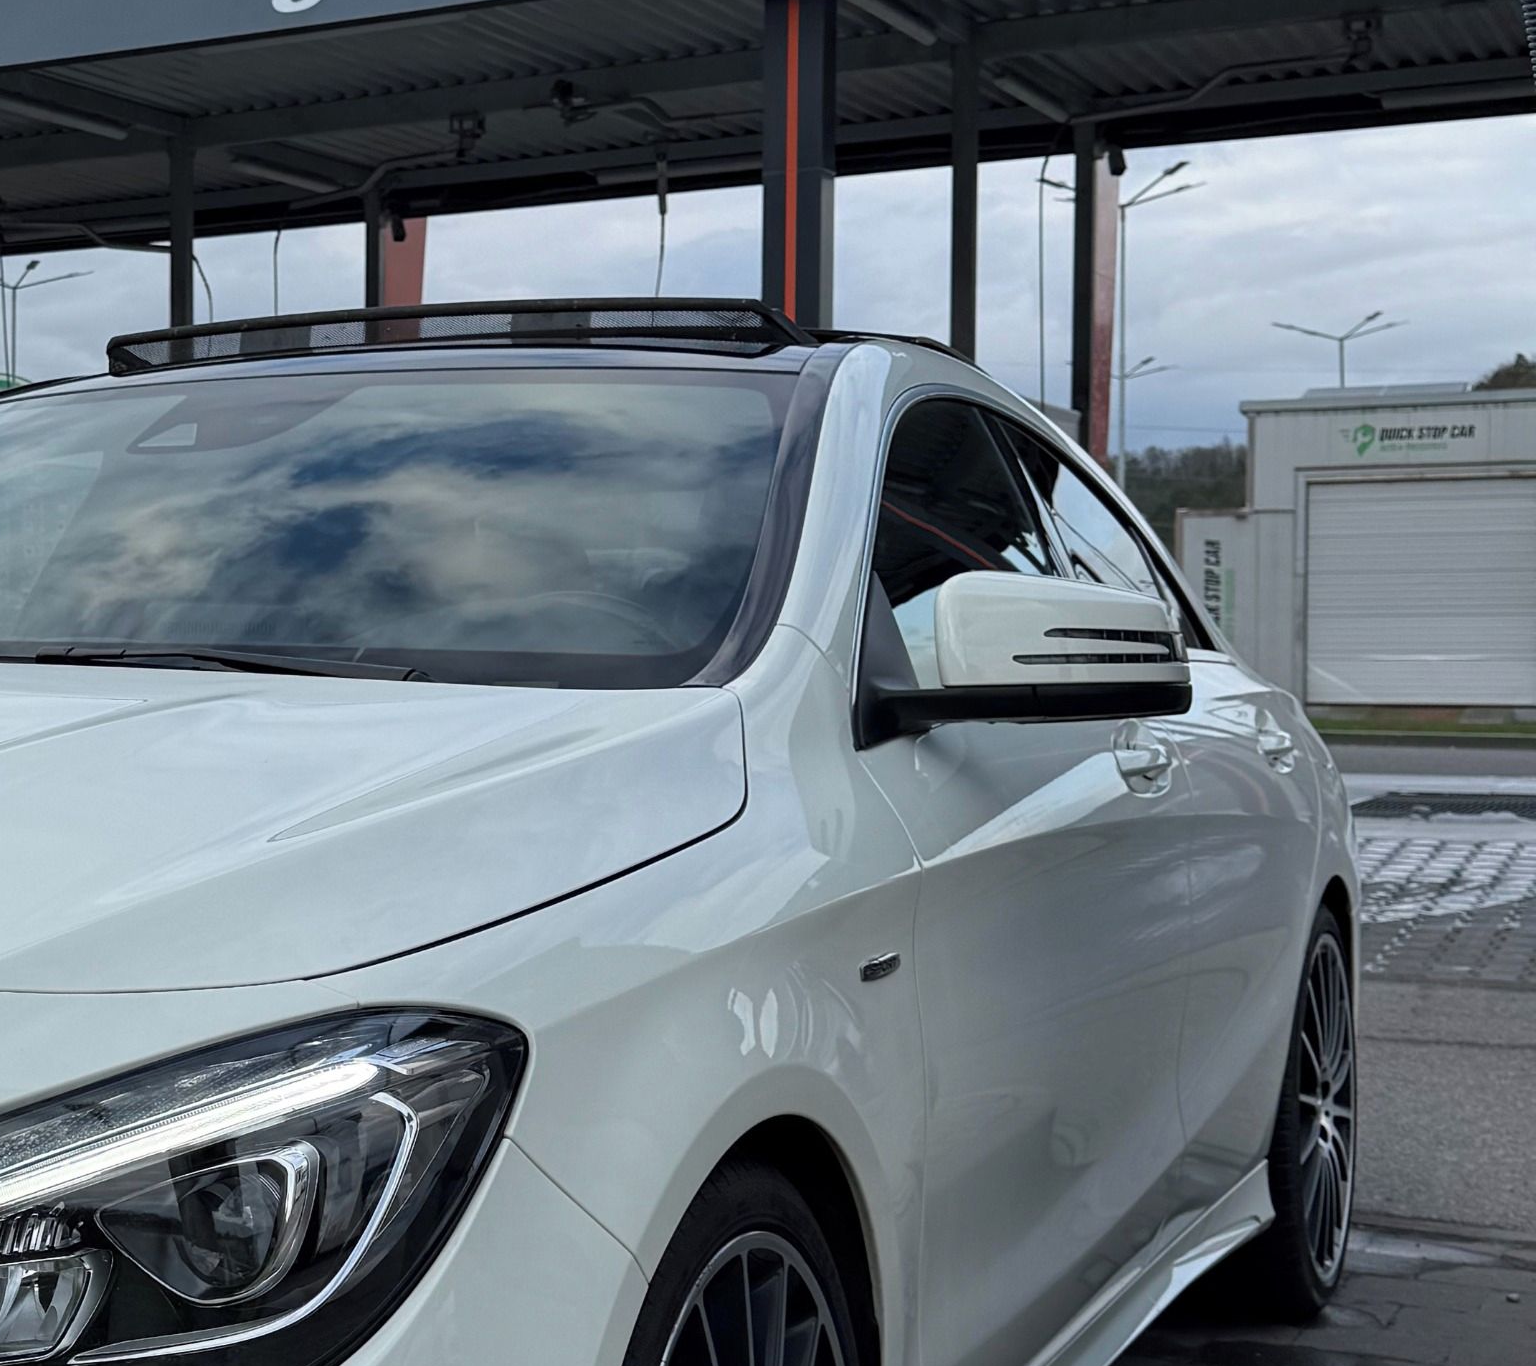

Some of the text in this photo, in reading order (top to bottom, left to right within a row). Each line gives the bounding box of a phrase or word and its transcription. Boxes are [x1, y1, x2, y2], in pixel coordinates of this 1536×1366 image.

[1379, 423, 1477, 442] QUICK STOP CAR
